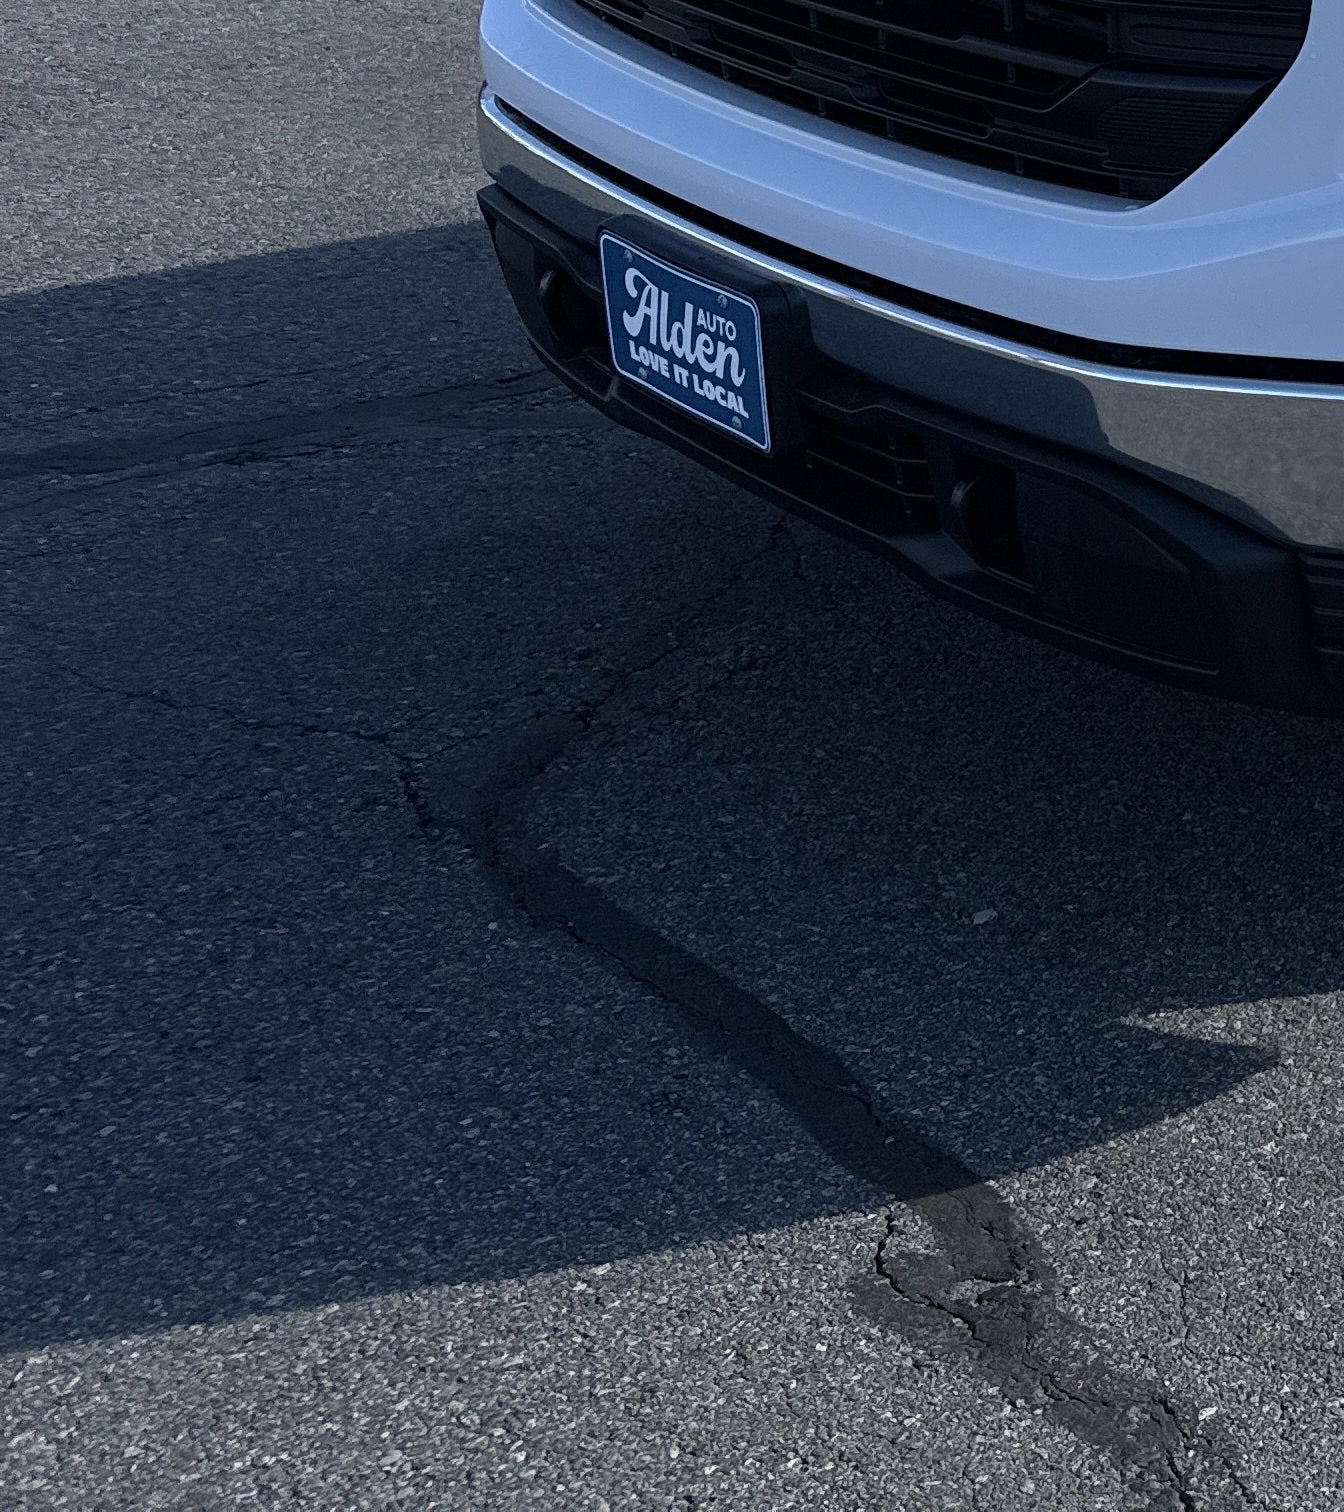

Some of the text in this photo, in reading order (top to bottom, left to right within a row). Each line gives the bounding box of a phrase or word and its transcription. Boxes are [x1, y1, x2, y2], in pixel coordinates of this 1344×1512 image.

[622, 267, 746, 387] Alden
[696, 307, 737, 341] AUTO
[629, 340, 750, 420] LOVE IT LOCAL
